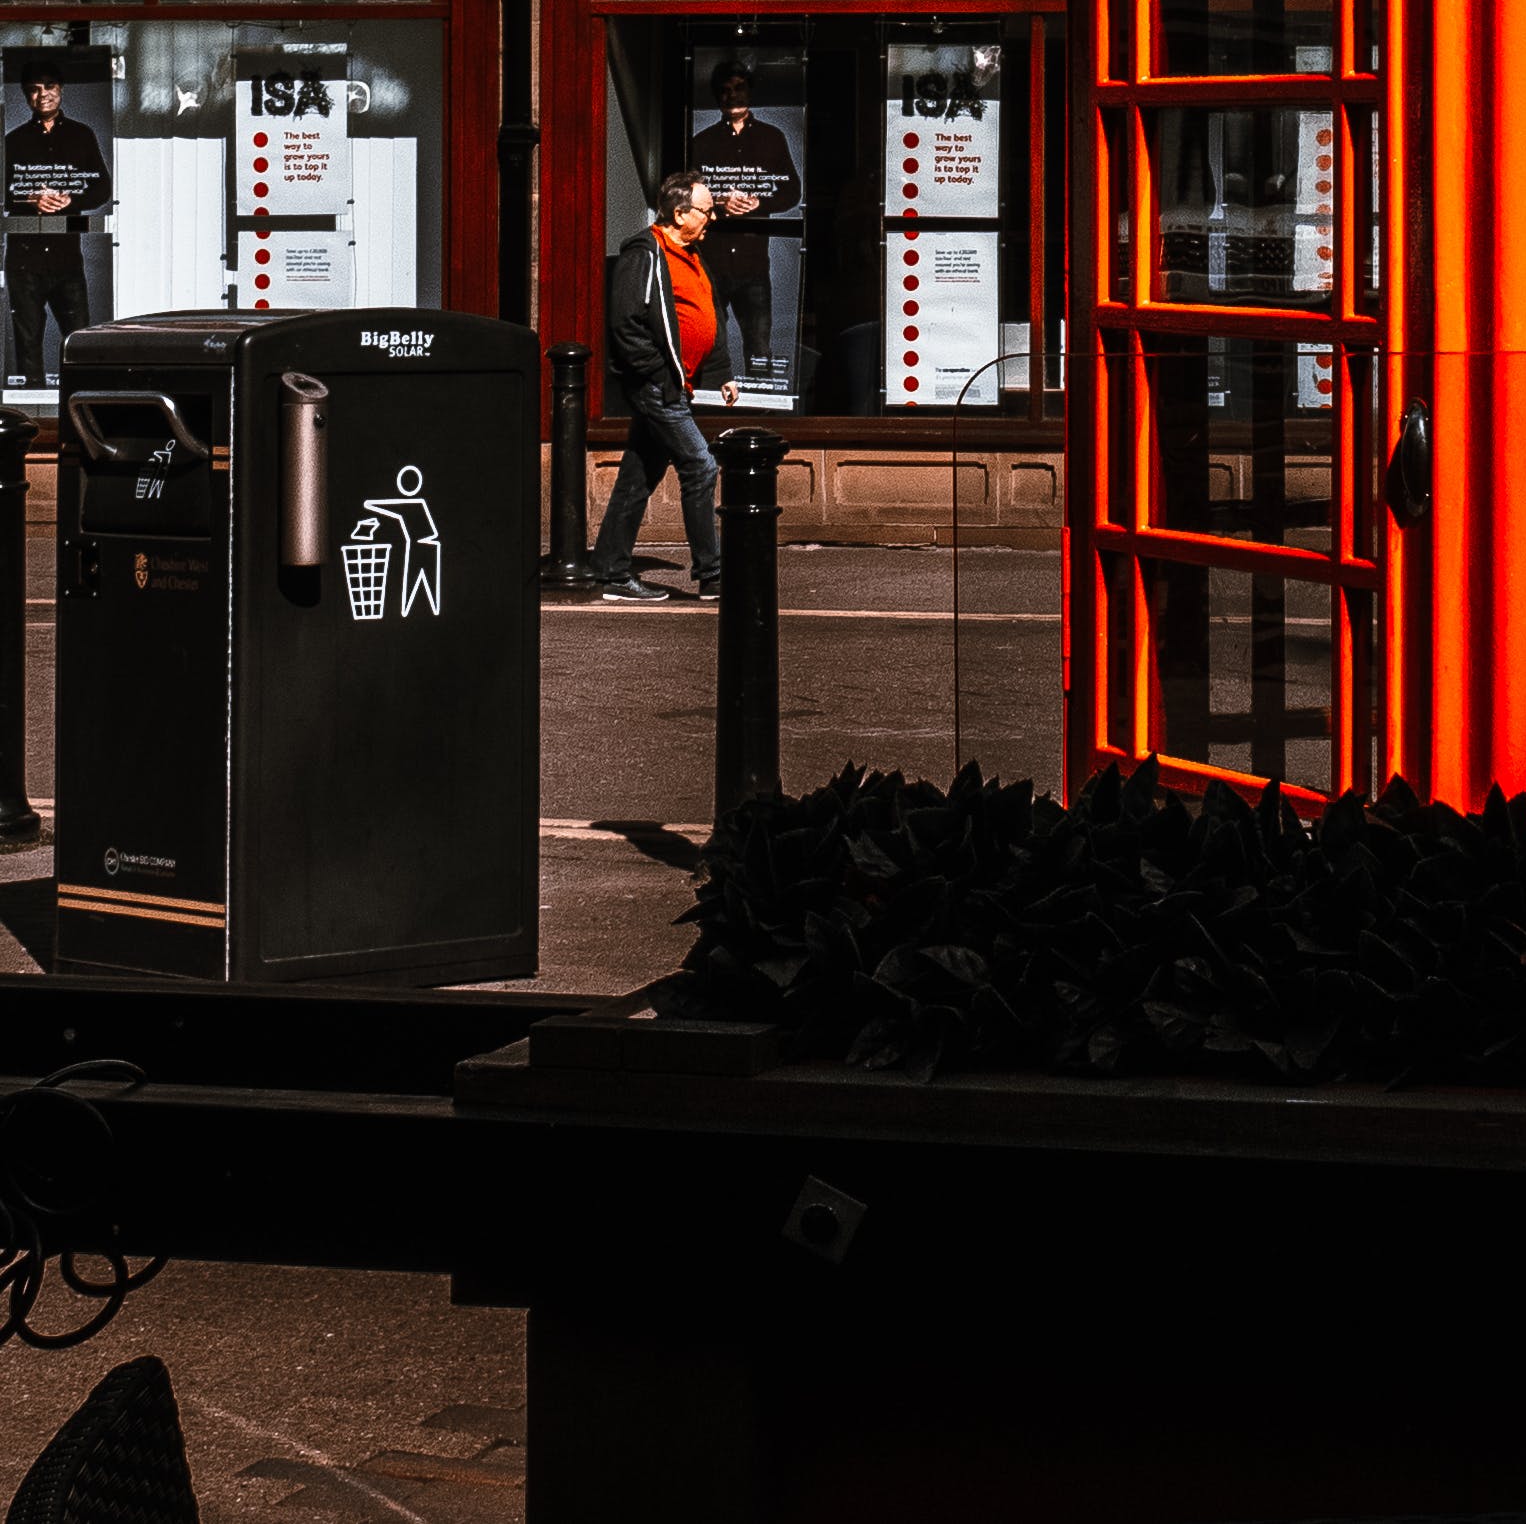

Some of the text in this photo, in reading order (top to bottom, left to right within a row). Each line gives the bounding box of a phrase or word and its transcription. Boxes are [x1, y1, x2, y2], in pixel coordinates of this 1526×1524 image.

[251, 70, 334, 119] ISA
[902, 71, 986, 121] ISA
[284, 132, 320, 140] The best
[935, 134, 972, 142] The best
[284, 142, 312, 152] way to
[935, 145, 953, 154] way
[284, 154, 330, 162] grow yours
[935, 155, 981, 164] grow yours
[304, 163, 319, 172] top
[321, 162, 328, 170] it
[944, 165, 953, 173] to
[956, 165, 970, 174] top
[972, 165, 979, 173] it
[284, 174, 295, 183] up
[935, 176, 946, 185] up
[360, 330, 435, 349] BigBelly
[389, 346, 424, 358] SOLAR
